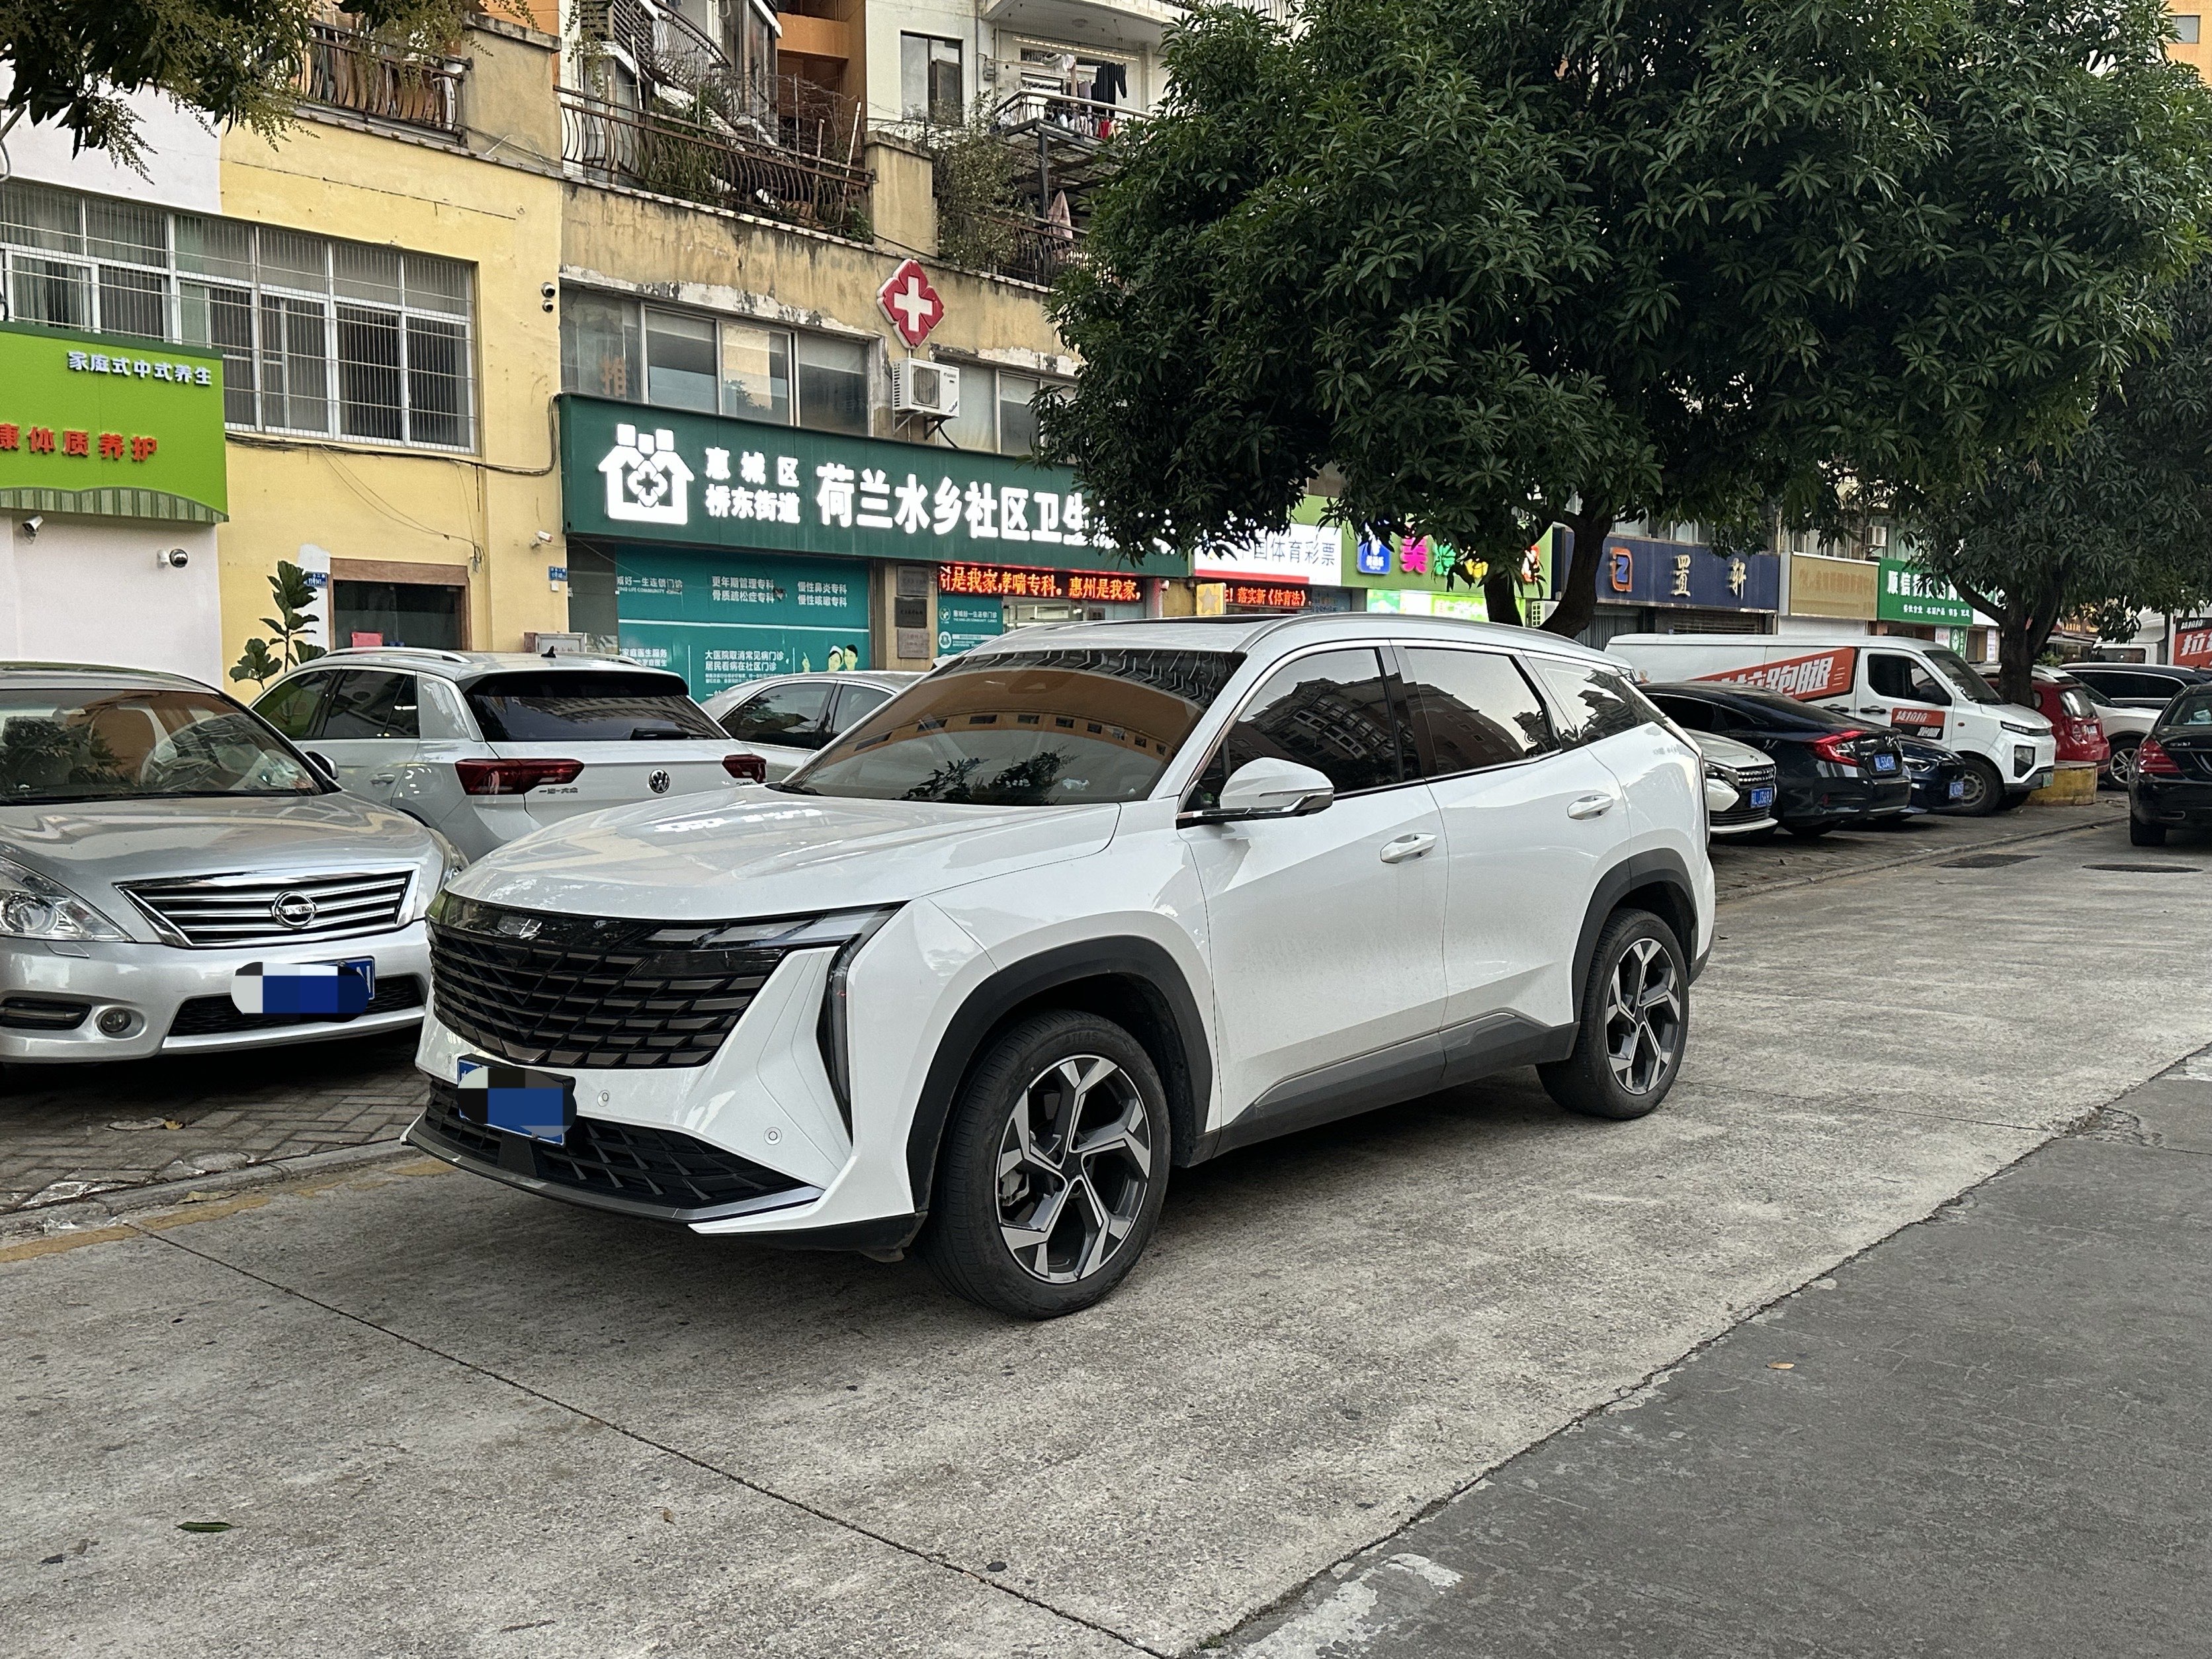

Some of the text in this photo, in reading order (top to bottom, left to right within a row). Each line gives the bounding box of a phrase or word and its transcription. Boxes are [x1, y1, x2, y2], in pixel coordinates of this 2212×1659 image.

[67, 351, 213, 386] 家庭式中式养生
[600, 354, 626, 397] 推
[0, 423, 158, 462] 康体质养护
[705, 447, 800, 488] 惠城区
[705, 483, 801, 524] 桥东街道
[816, 462, 1176, 554] 荷兰水乡社区卫生
[1241, 536, 1336, 566] 国体育彩票
[712, 576, 774, 590] 更年期管理专科
[712, 589, 775, 603] 骨质疏松症专科
[619, 648, 667, 658] 家庭医生服务
